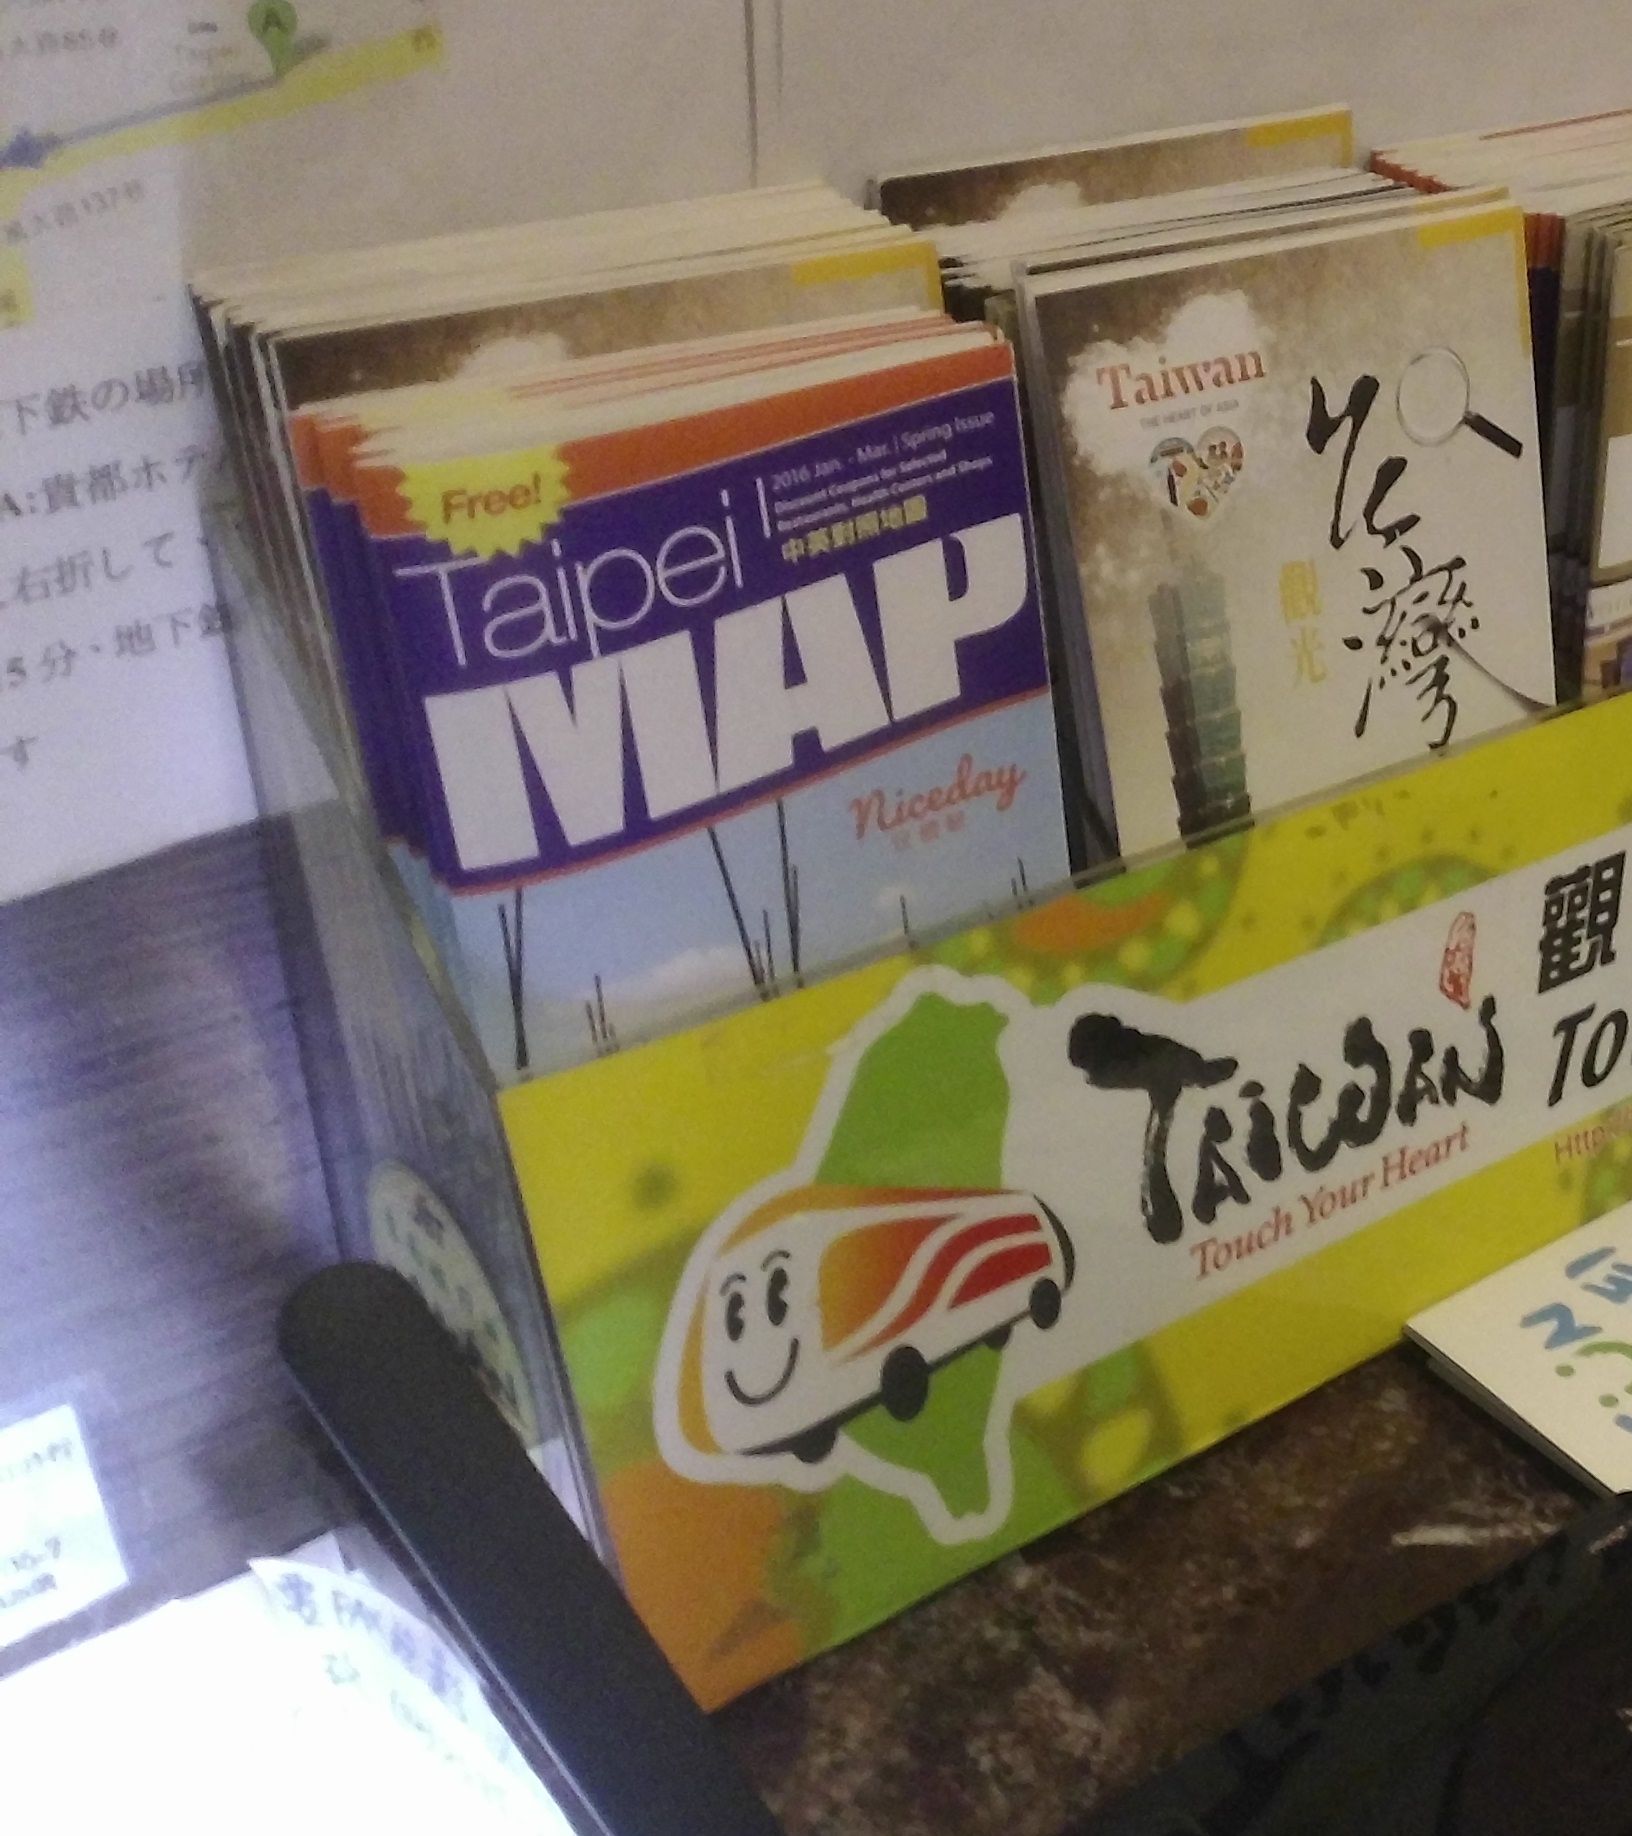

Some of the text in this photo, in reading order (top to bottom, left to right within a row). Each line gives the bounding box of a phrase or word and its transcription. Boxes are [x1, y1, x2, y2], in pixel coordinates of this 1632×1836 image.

[1096, 346, 1266, 411] Taiwan
[901, 423, 952, 450] Spring
[441, 475, 542, 526] Free!
[395, 488, 744, 667] Taipei
[423, 512, 1029, 873] MAP
[849, 753, 1027, 840] Niceday
[1190, 1121, 1470, 1281] Touch Your Heart
